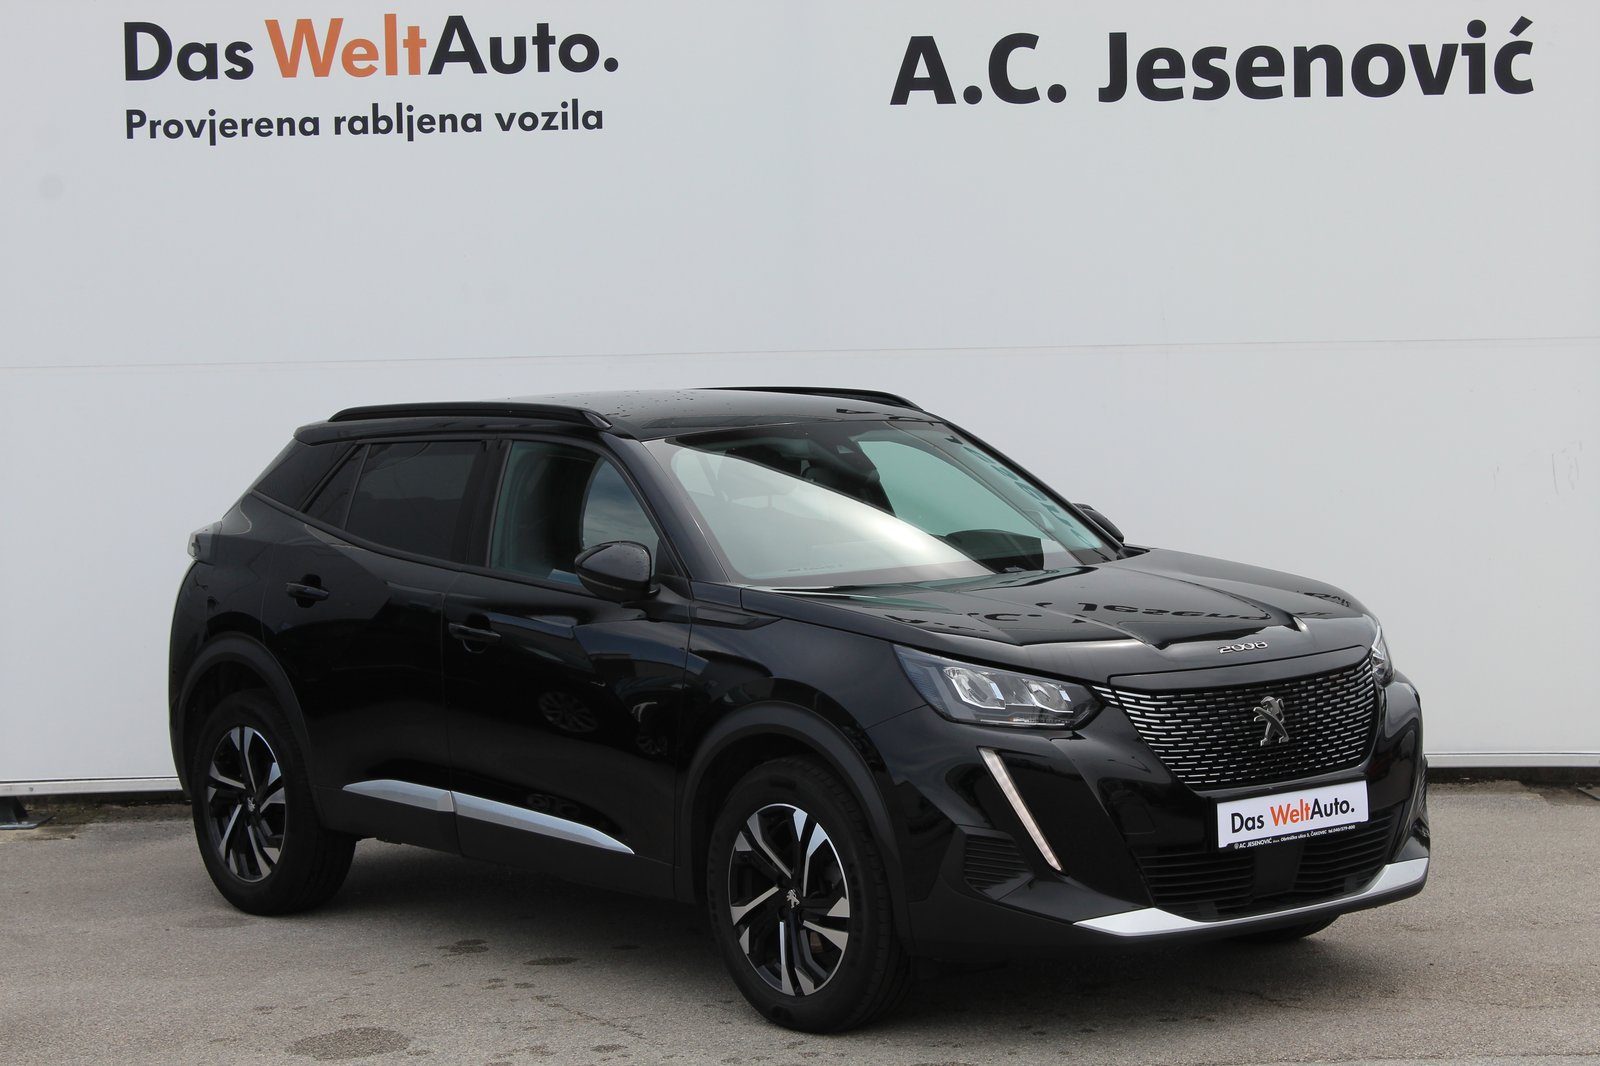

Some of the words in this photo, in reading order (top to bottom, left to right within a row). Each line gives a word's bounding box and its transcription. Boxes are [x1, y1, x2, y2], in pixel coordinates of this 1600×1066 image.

[124, 22, 254, 81] Das
[265, 14, 619, 78] WeltAuto.
[890, 33, 1067, 105] A.C.
[1098, 16, 1534, 102] Jesenović
[126, 109, 320, 146] Provjerena
[333, 103, 482, 142] rabljena
[494, 99, 603, 132] vozila
[1217, 641, 1268, 654] 2008
[1230, 812, 1265, 834] Das
[1269, 798, 1355, 827] WeltAuto.
